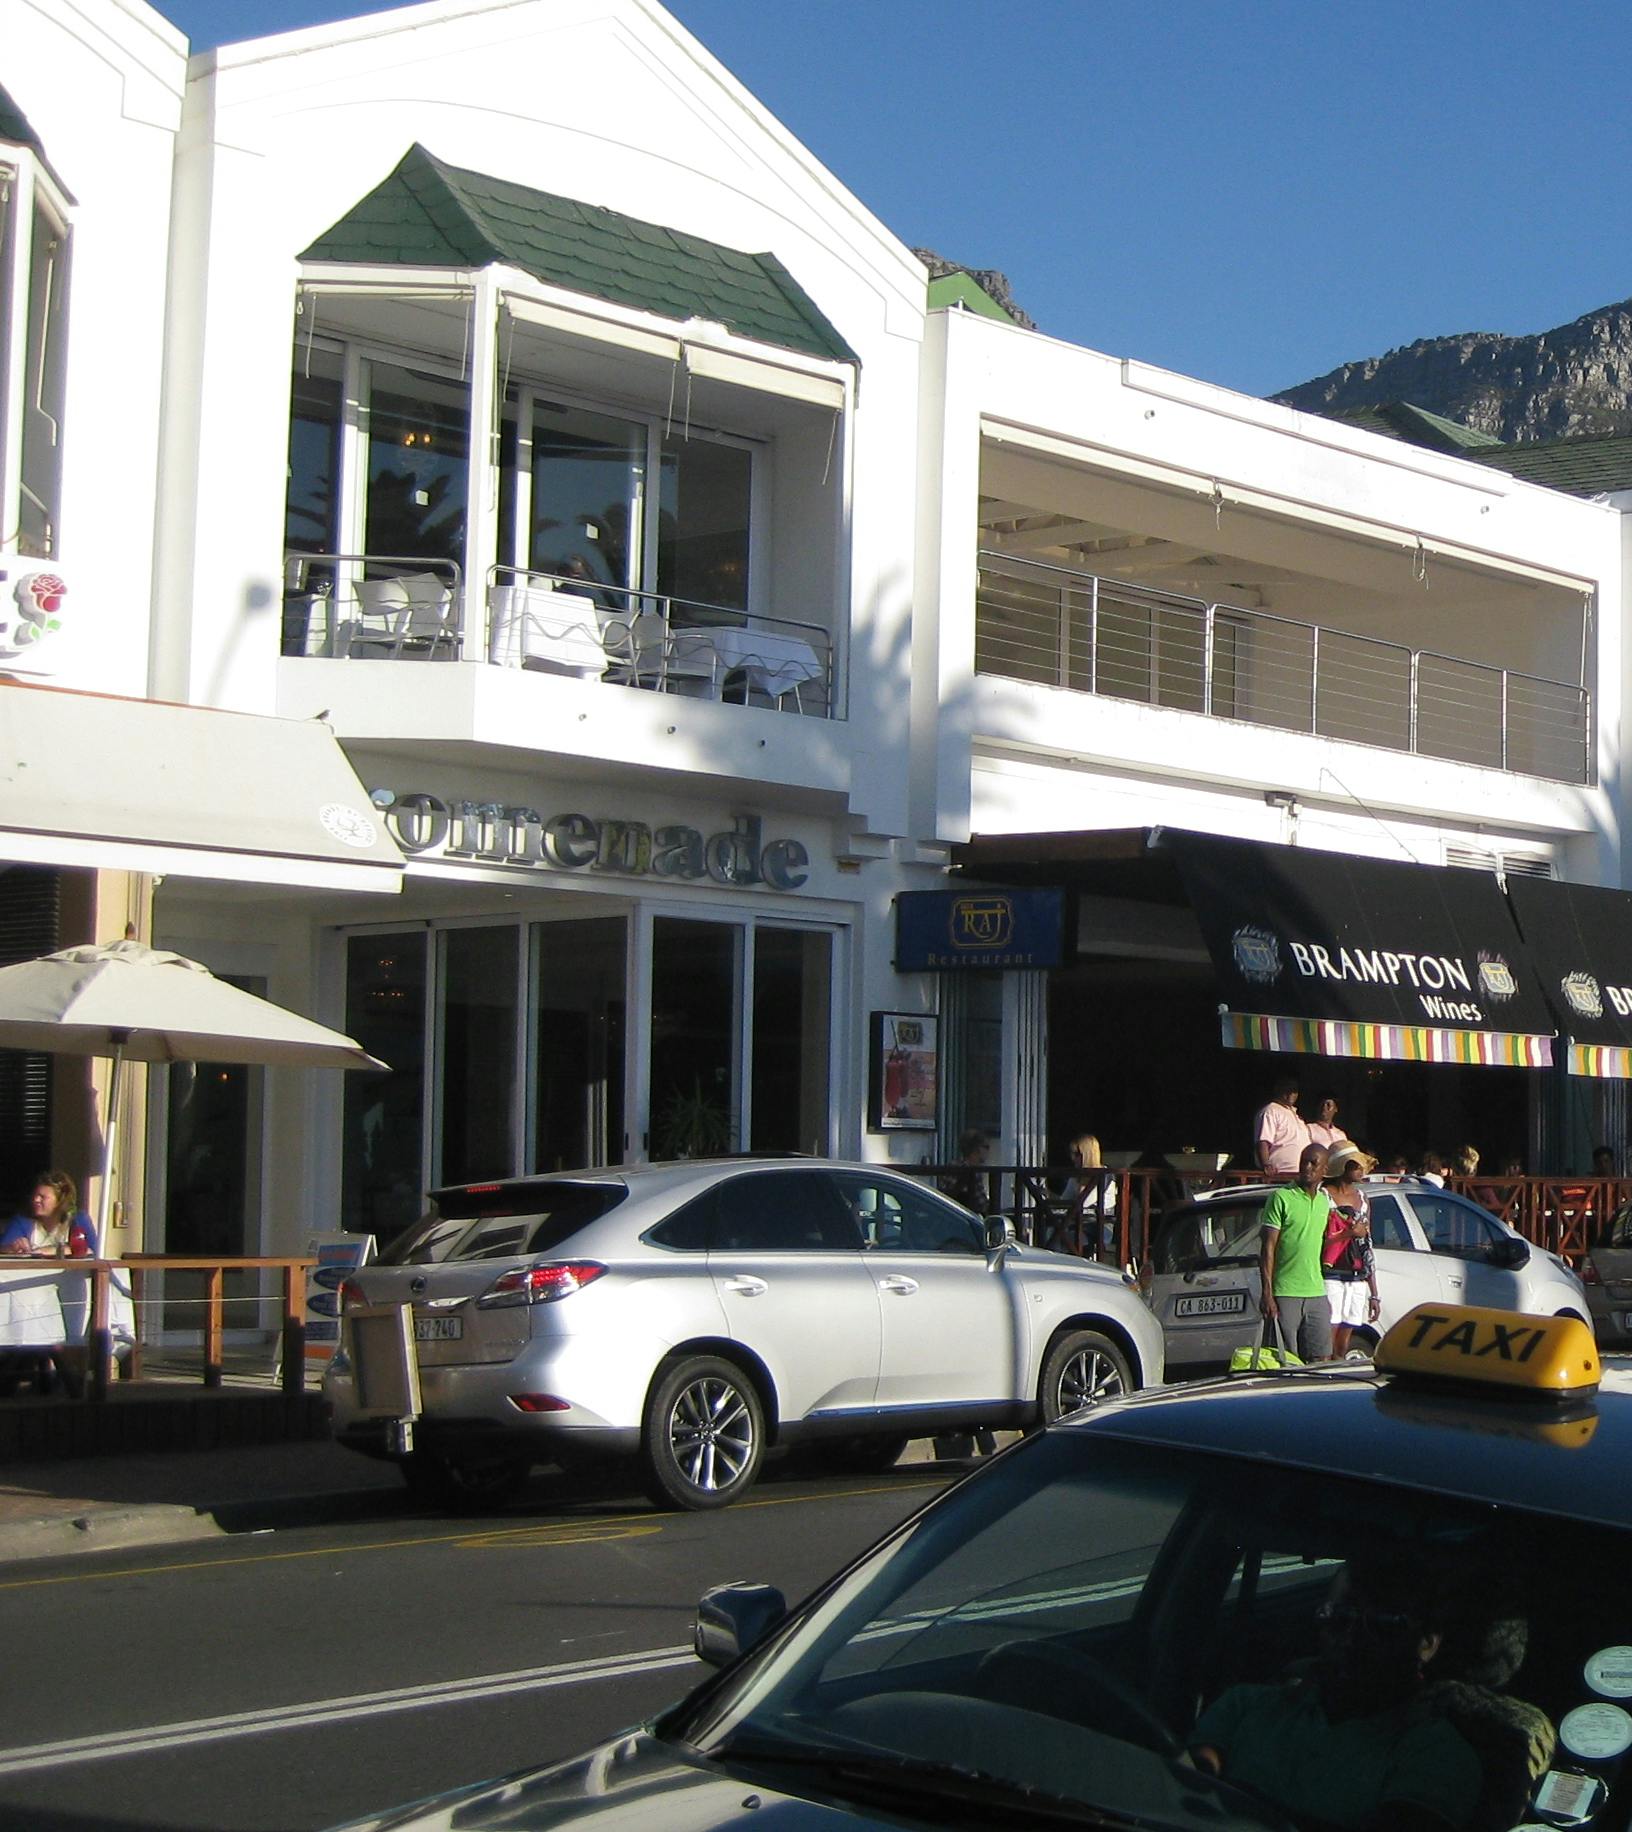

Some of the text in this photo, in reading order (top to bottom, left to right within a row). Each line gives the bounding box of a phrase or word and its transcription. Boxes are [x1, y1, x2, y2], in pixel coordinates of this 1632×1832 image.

[370, 787, 809, 891] omenade
[927, 953, 1033, 966] Restaurant
[1289, 941, 1473, 992] BRAMPTON
[1419, 994, 1483, 1022] Wines
[1181, 1299, 1192, 1314] CA
[1408, 1314, 1547, 1362] TAXI
